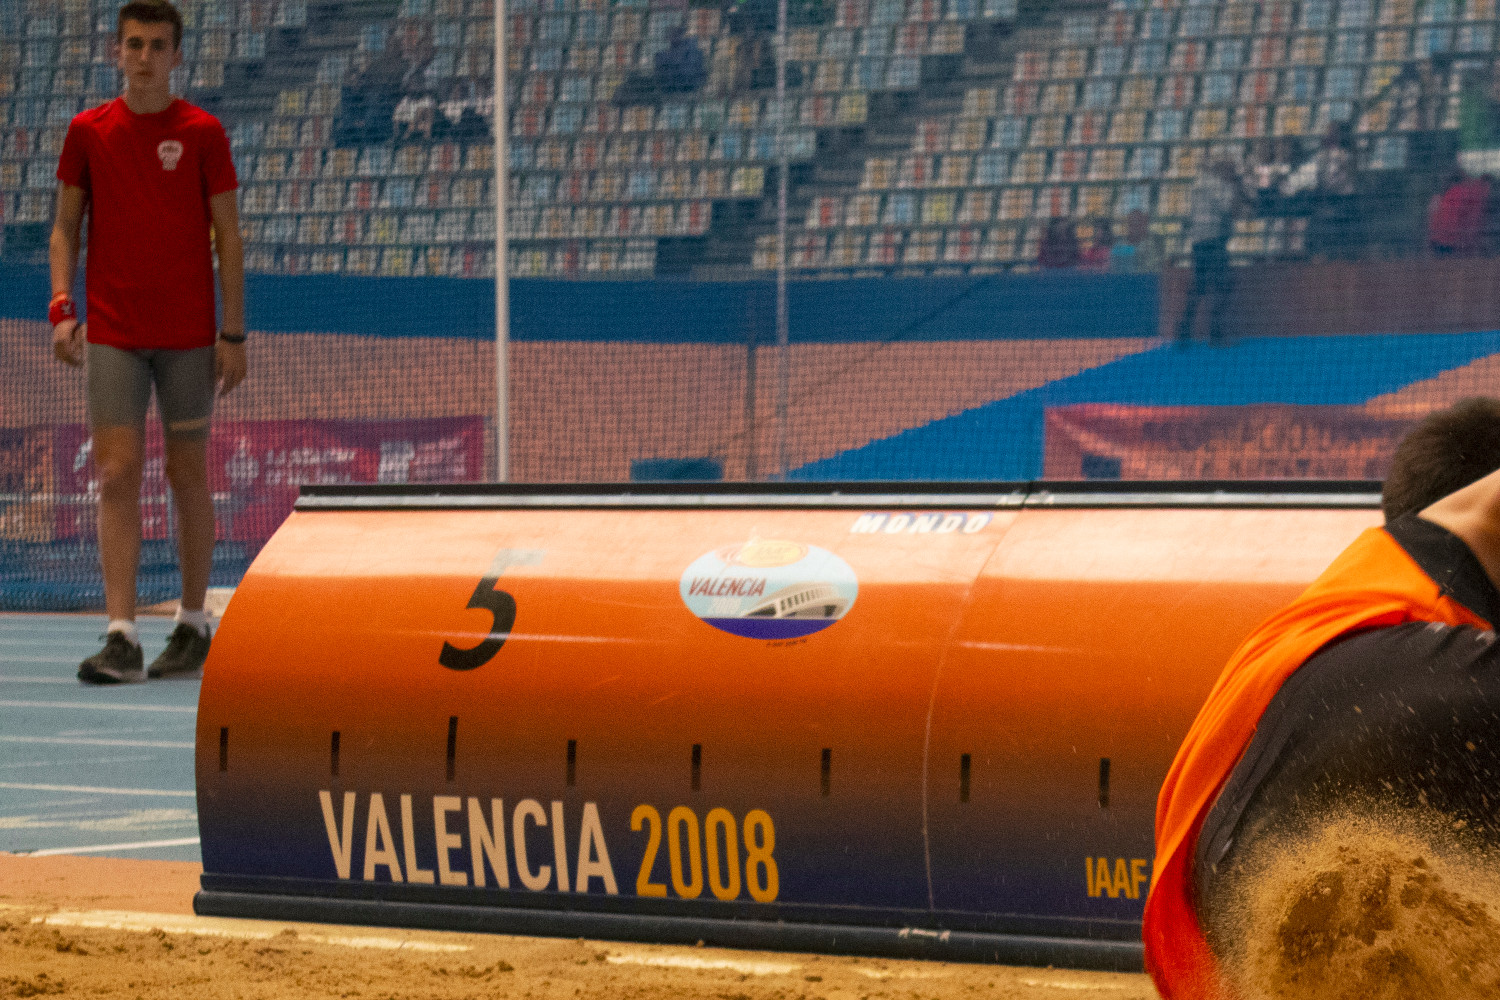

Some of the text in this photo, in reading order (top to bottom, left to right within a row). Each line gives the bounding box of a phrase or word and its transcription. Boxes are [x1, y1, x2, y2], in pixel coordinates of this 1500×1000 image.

[850, 511, 994, 534] MONDO
[688, 576, 768, 598] VALENCIA
[438, 548, 549, 672] 5
[318, 790, 780, 903] VALENCIA 2008
[1085, 856, 1147, 899] IAAF
